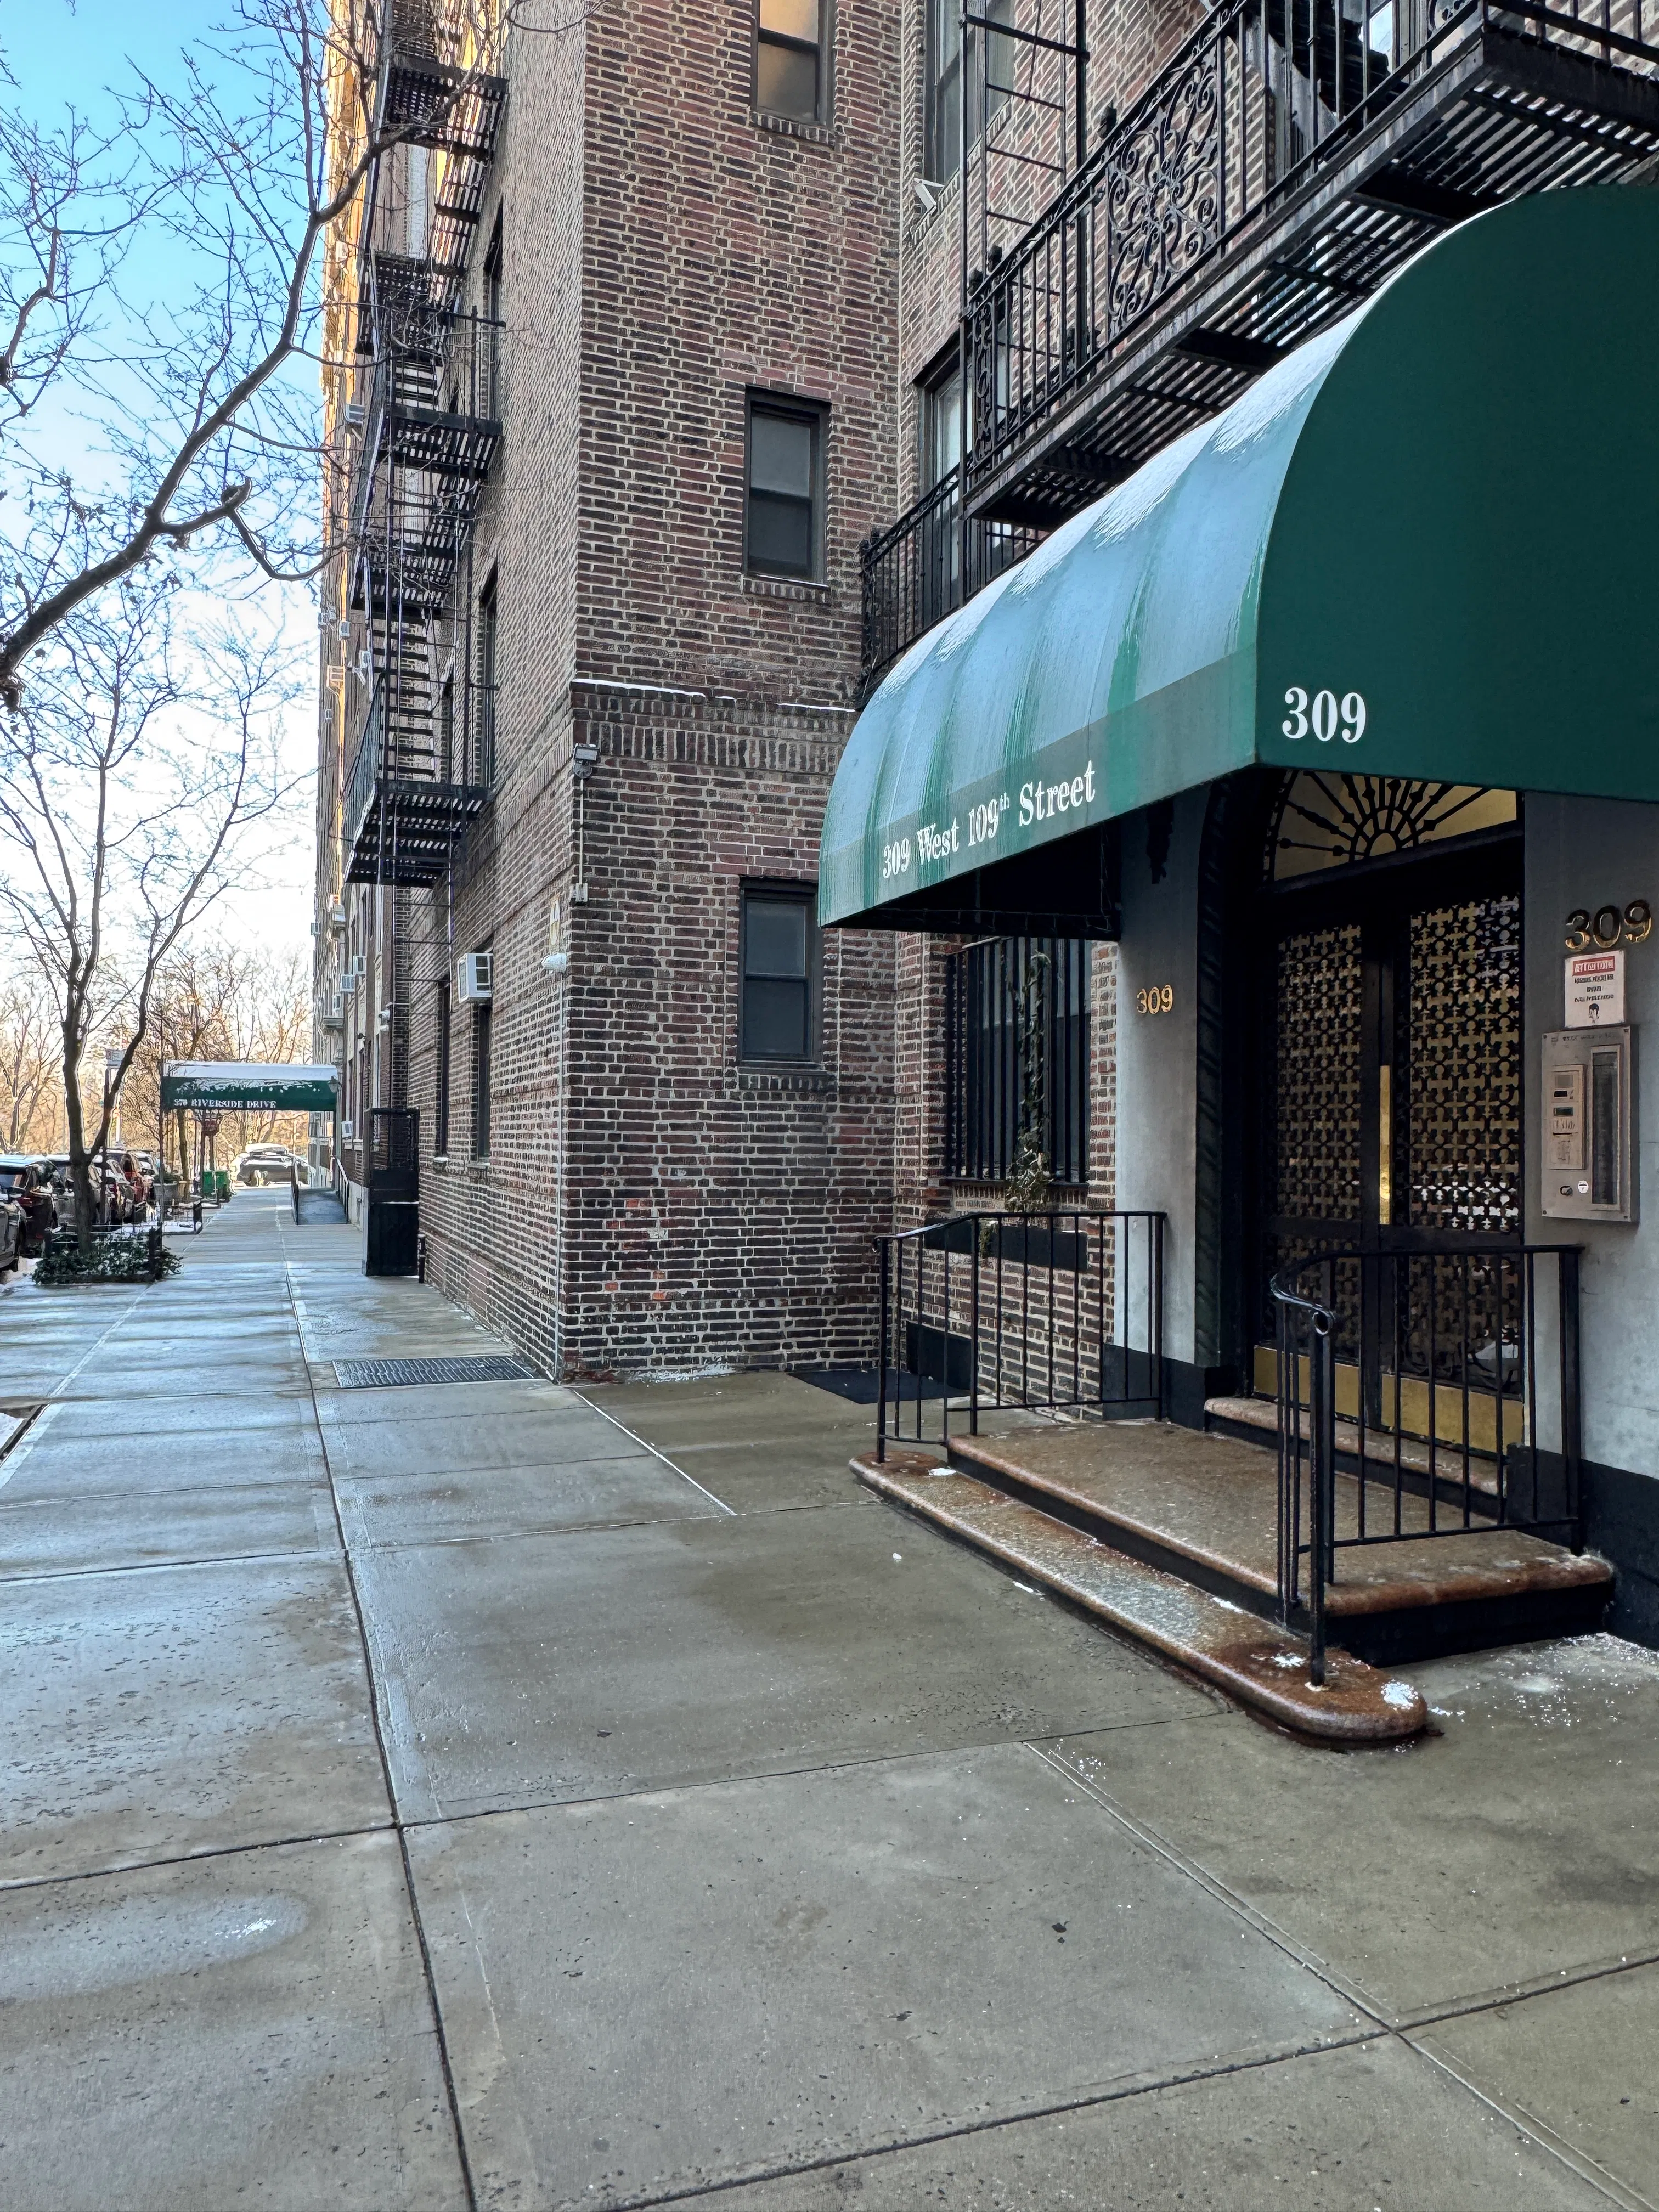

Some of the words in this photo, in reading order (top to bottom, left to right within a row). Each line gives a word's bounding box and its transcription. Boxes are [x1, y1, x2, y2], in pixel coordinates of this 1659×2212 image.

[1282, 687, 1366, 743] 309
[883, 838, 910, 879] 309
[917, 817, 960, 865] West
[968, 792, 1009, 847] 109th
[1019, 760, 1096, 826] Street
[1565, 899, 1652, 950] 309
[1137, 984, 1173, 1014] 309
